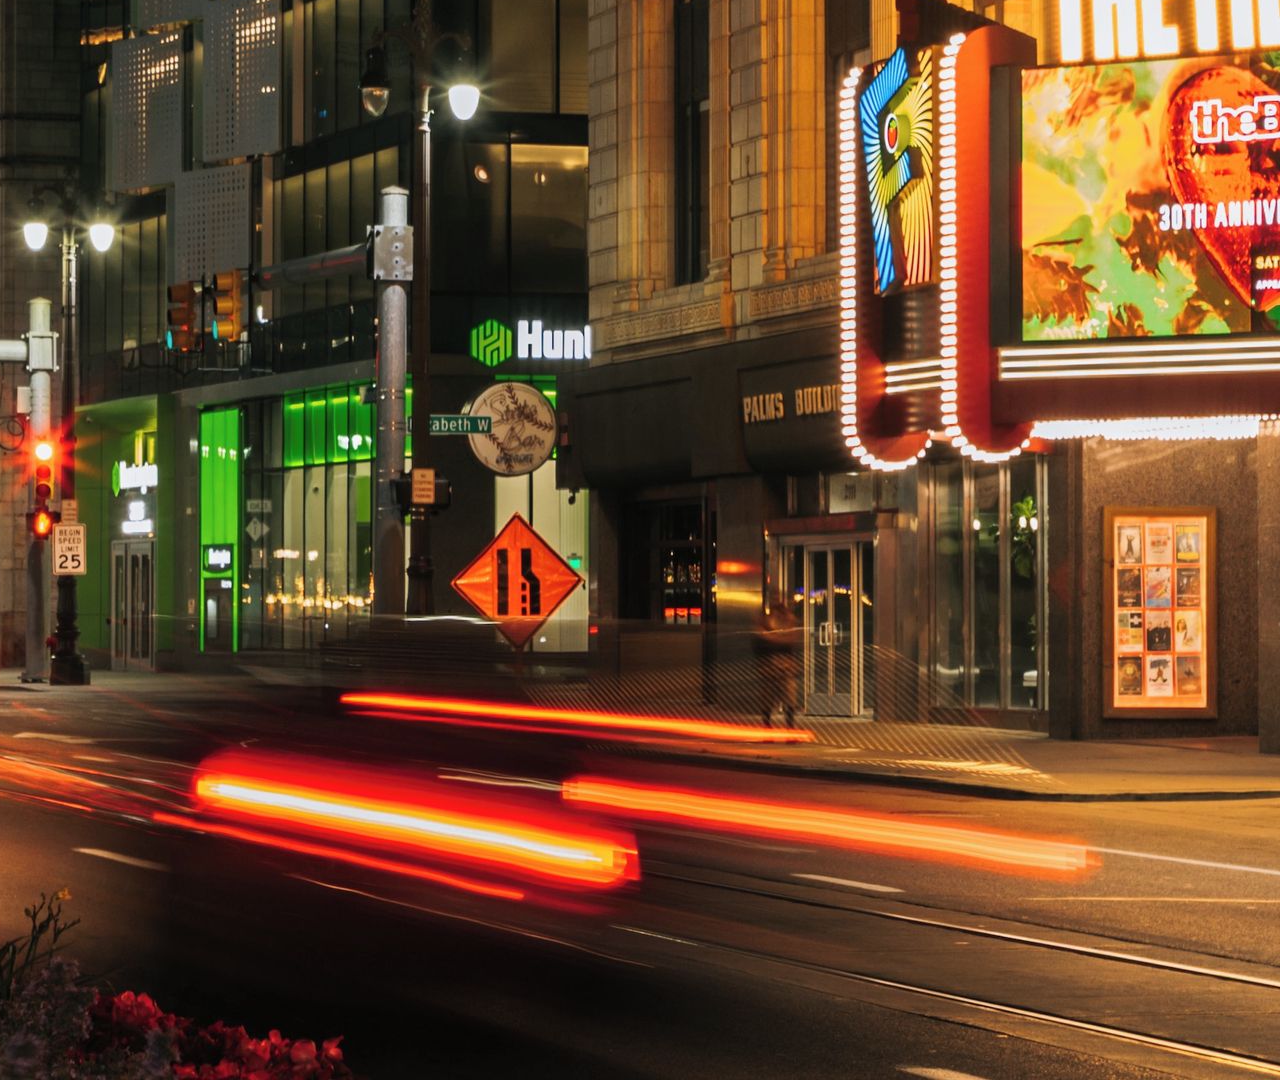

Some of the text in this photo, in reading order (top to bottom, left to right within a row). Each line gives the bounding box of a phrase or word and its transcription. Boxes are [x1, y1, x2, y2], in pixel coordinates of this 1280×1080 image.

[1158, 203, 1208, 232] 30TH
[743, 383, 841, 424] PALMS BUILDI
[477, 418, 489, 431] W
[58, 537, 82, 545] SPEED
[58, 554, 81, 569] 25
